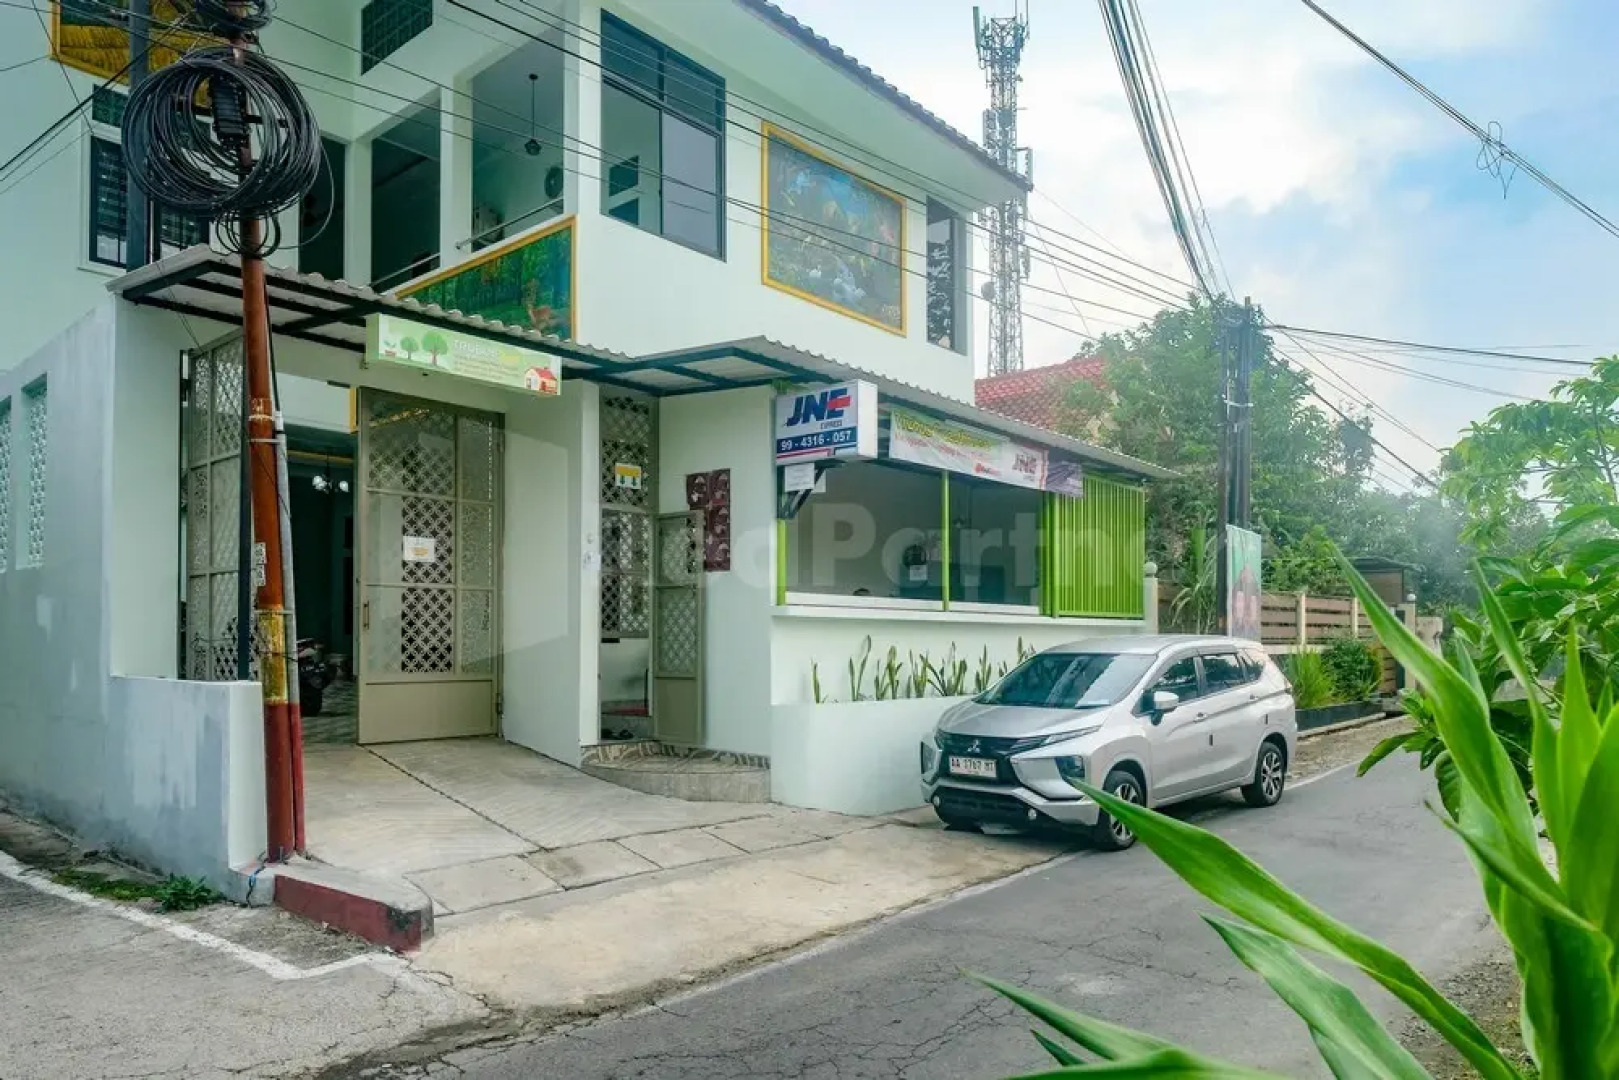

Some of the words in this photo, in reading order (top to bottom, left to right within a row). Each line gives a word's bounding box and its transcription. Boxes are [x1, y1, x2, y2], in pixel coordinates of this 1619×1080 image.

[786, 388, 851, 427] JNE
[781, 440, 793, 451] 99
[800, 435, 825, 448] 4316
[833, 430, 852, 443] 057
[952, 758, 961, 768] AA
